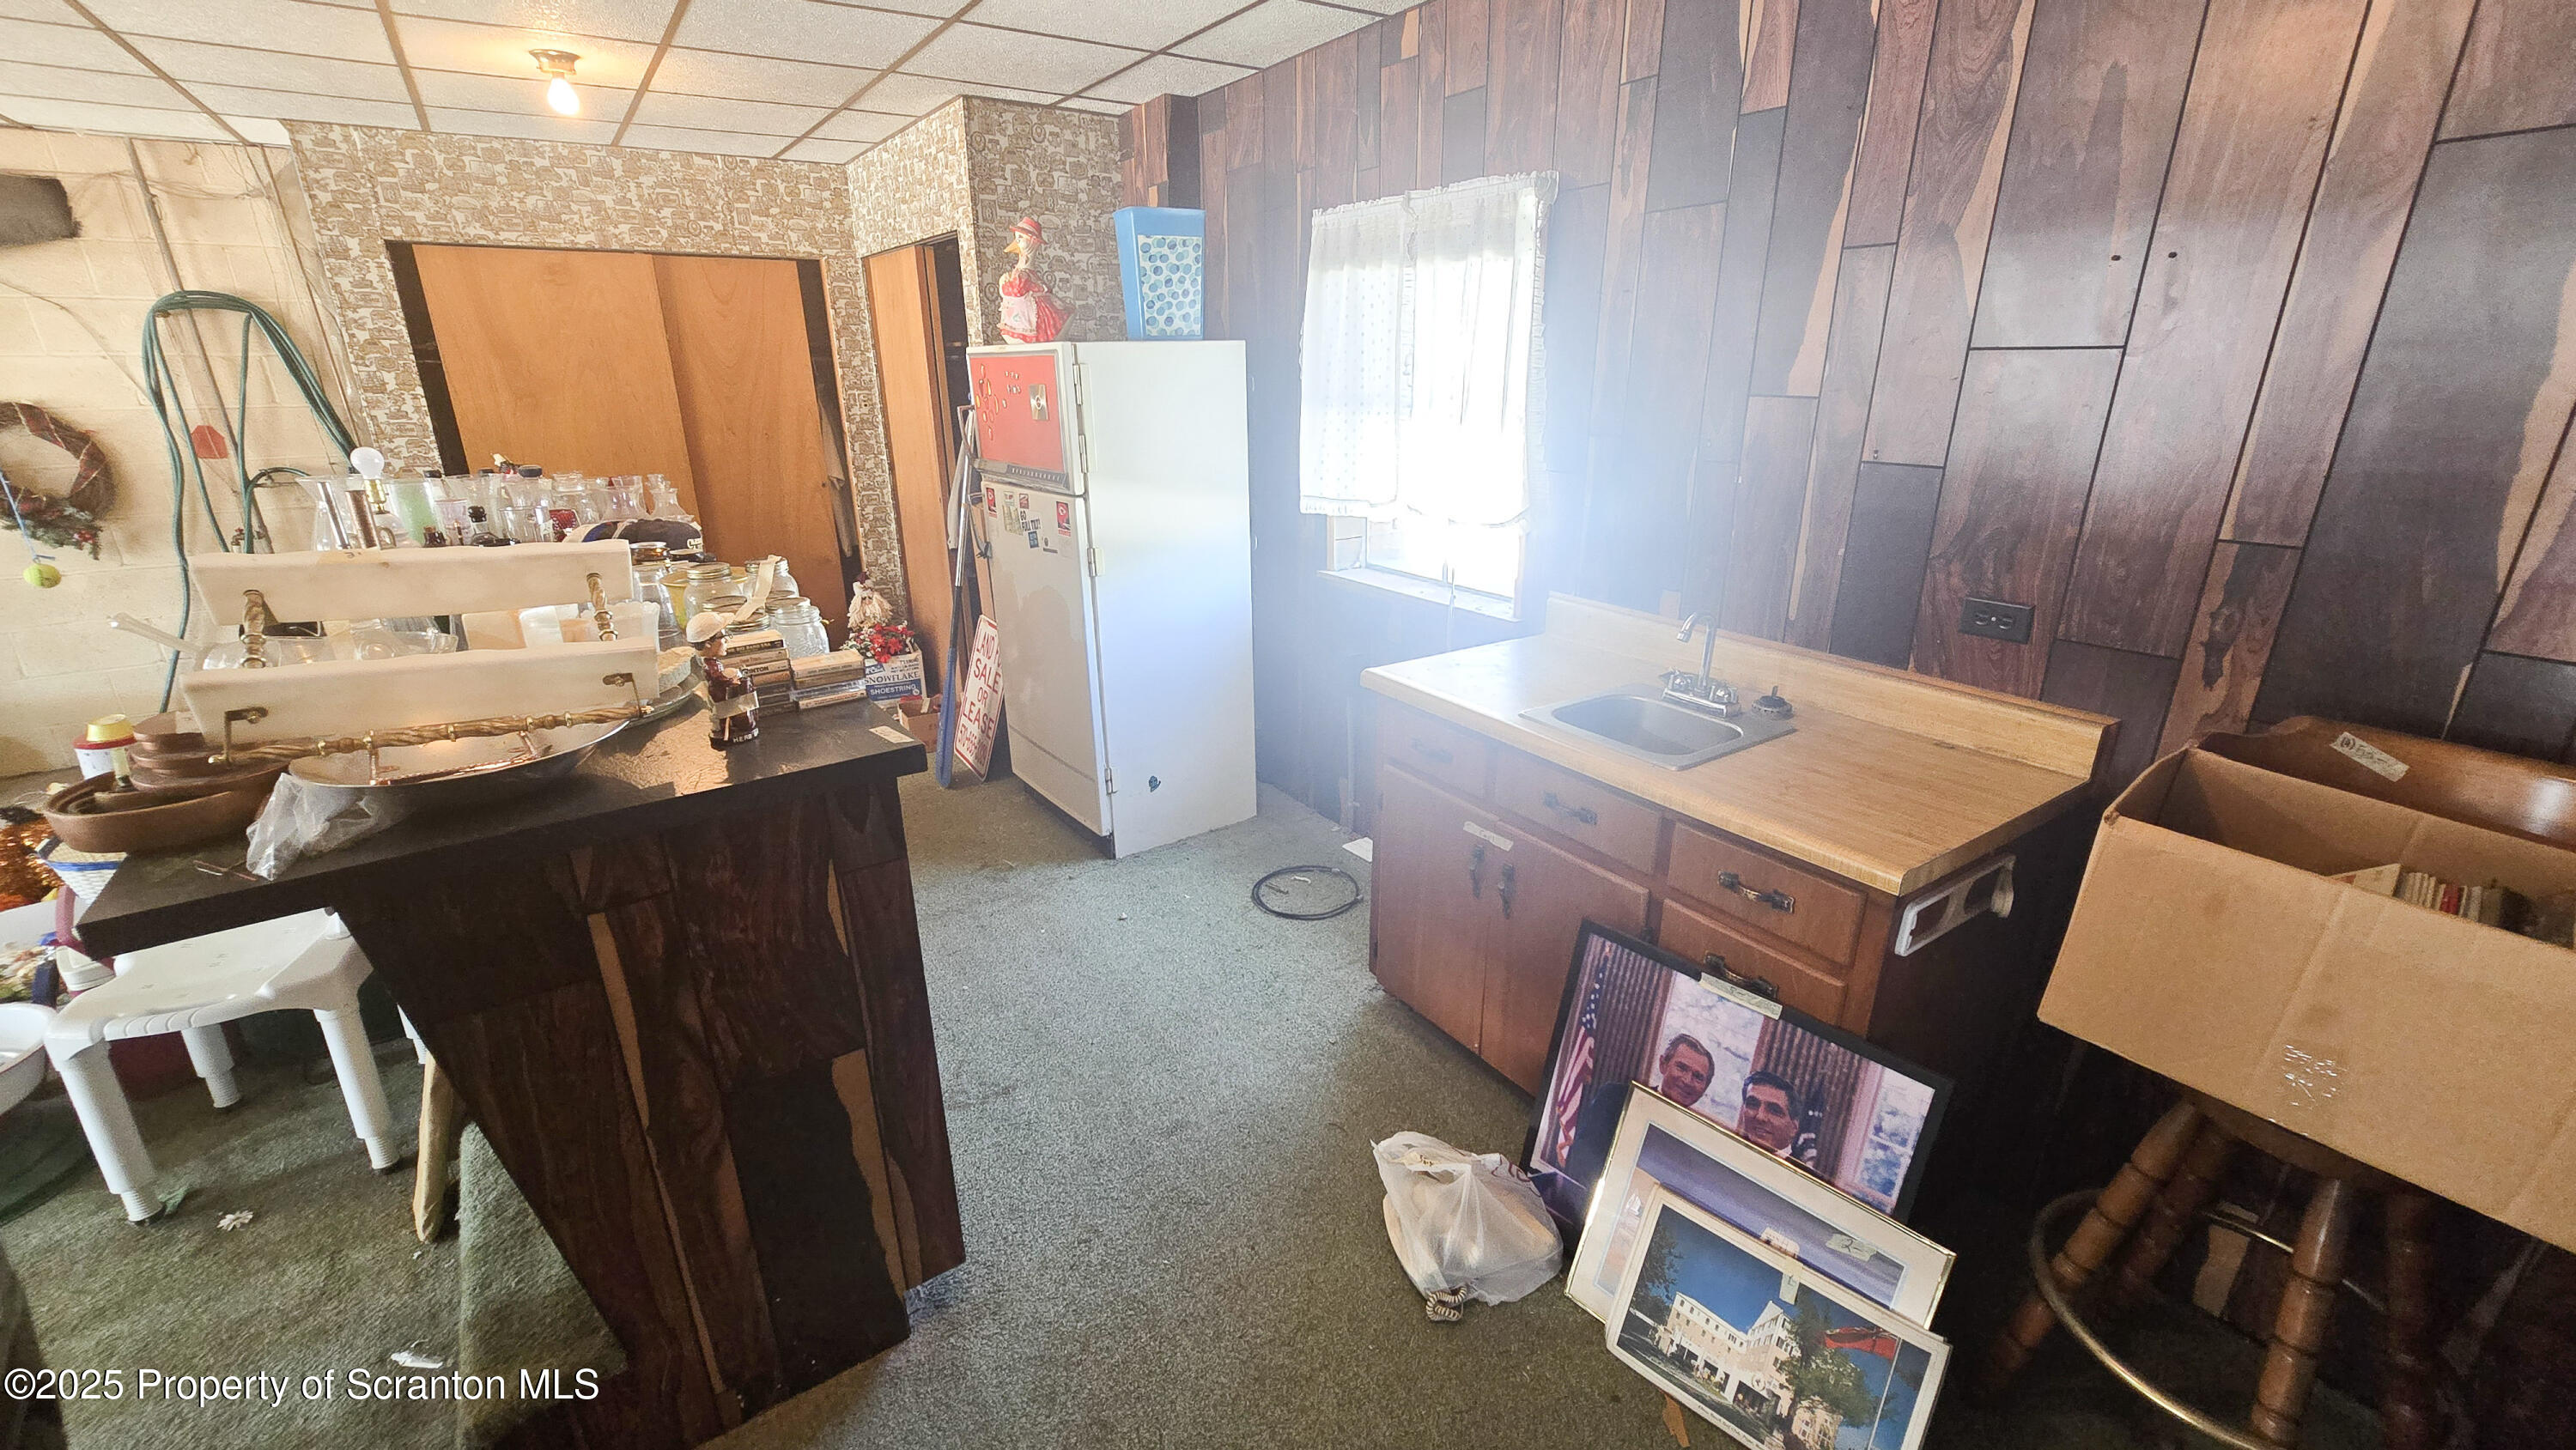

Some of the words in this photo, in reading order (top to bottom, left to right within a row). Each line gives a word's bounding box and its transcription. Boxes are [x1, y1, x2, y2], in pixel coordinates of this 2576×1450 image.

[976, 628, 995, 660] LAND
[865, 671, 920, 684] SNOWFLAKE
[974, 658, 1001, 695] SALE
[977, 687, 988, 707] OR
[963, 696, 995, 740] LEASE
